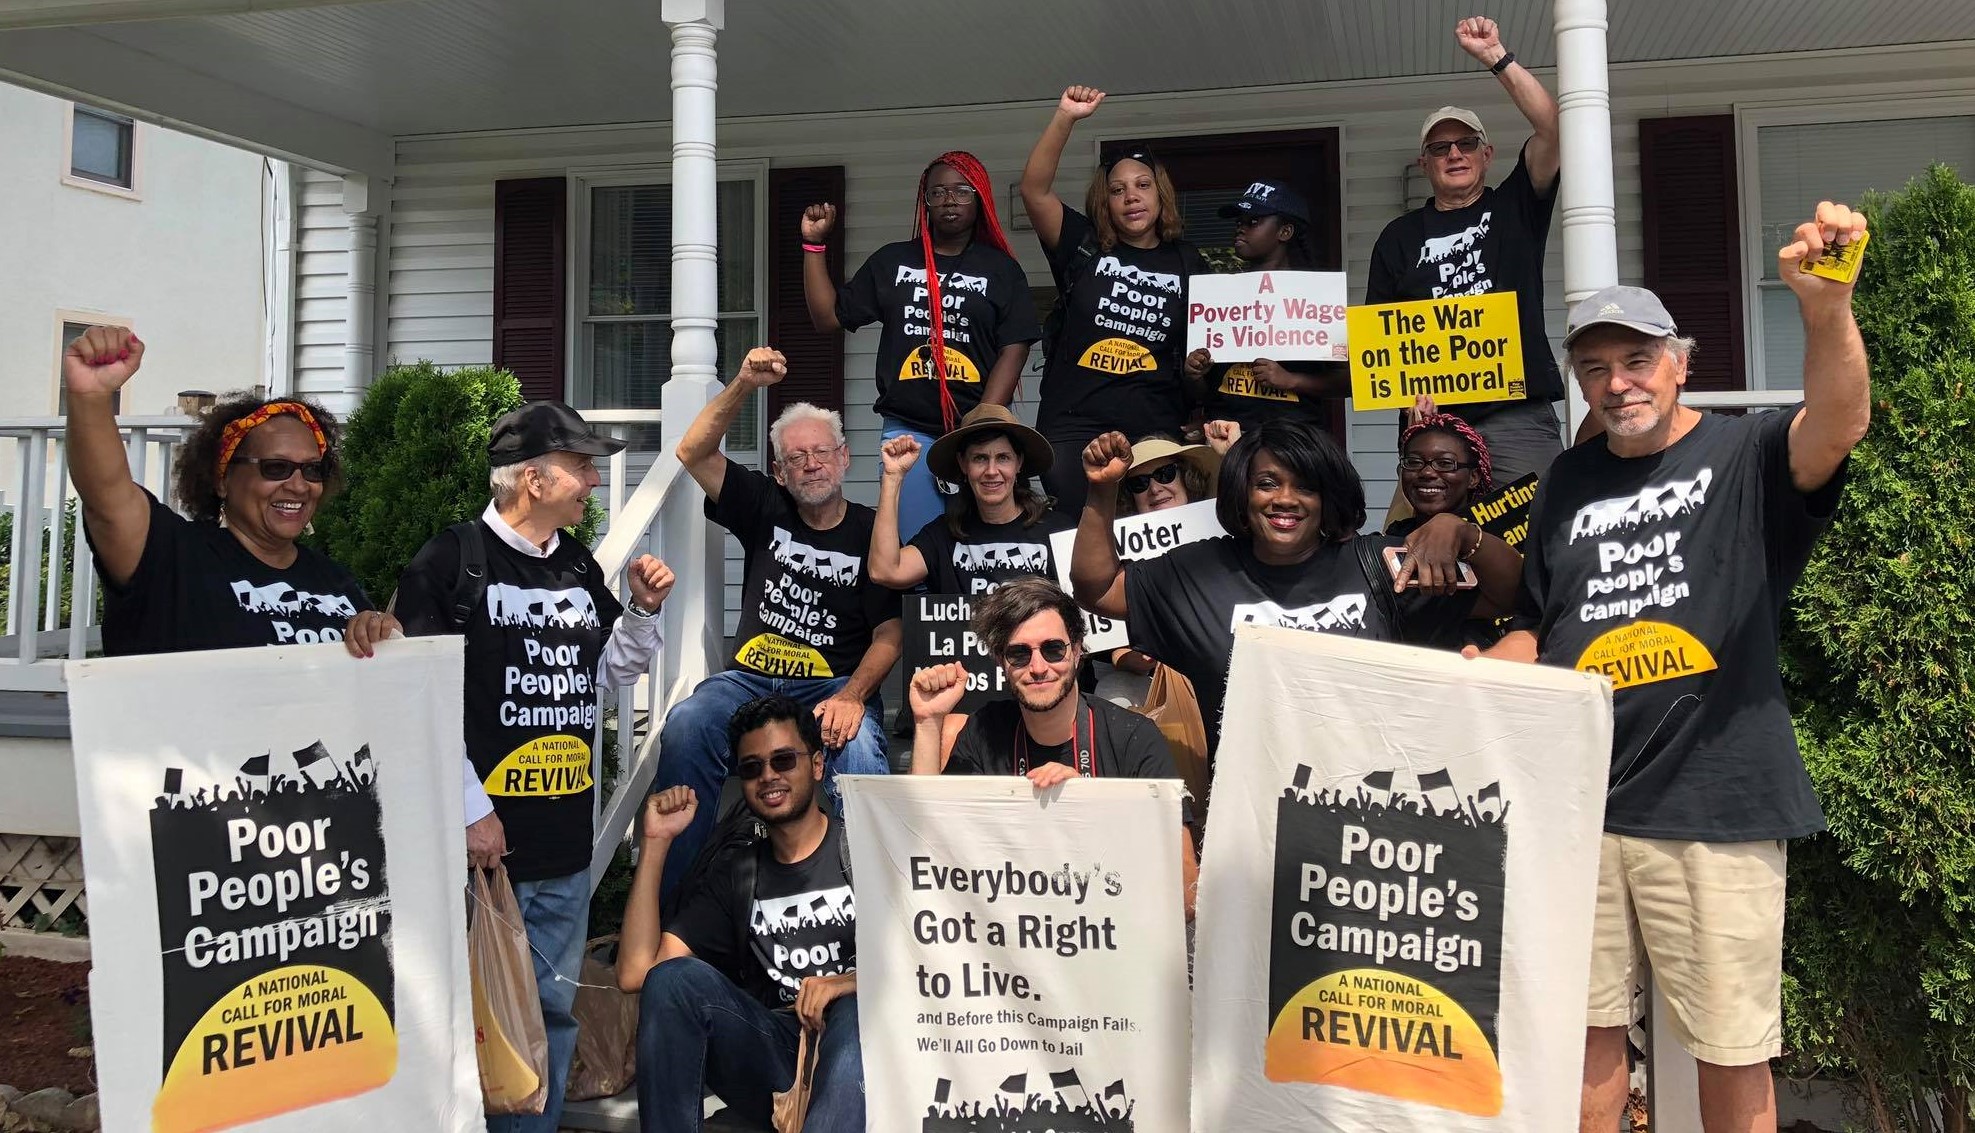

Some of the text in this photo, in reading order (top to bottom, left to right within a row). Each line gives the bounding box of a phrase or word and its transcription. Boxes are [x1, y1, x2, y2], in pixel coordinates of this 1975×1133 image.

[913, 286, 965, 309] Por
[1111, 281, 1166, 309] Poor
[1258, 272, 1274, 294] A
[904, 305, 969, 327] Peole's
[1098, 297, 1171, 327] People's
[1190, 298, 1345, 324] Poverty Wage
[1378, 304, 1484, 335] The War
[904, 323, 970, 343] Camaign
[1094, 314, 1166, 342] Campaign
[1206, 325, 1328, 348] is Violence
[1100, 345, 1113, 353] CALL
[1362, 347, 1391, 368] on
[1399, 339, 1440, 365] the
[1449, 335, 1508, 361] Poor
[1370, 373, 1392, 399] is
[1400, 362, 1504, 396] Immoral
[1598, 531, 1682, 573] Poor
[779, 572, 822, 606] Poor
[271, 620, 346, 645] Poo
[929, 631, 955, 656] La
[1605, 636, 1612, 646] A
[523, 638, 581, 667] Poor
[783, 649, 811, 659] MORAL
[1593, 649, 1616, 660] CALL
[1639, 635, 1676, 650] MORAL
[518, 754, 542, 764] CALL
[545, 753, 562, 764] FOR
[532, 740, 580, 751] A NATIONAL
[227, 817, 332, 863] Poor
[1341, 824, 1443, 874] Poor
[188, 850, 370, 916] People's
[910, 856, 1123, 905] Everybody's
[1300, 862, 1480, 922] People's
[185, 904, 378, 968] Campaign
[914, 909, 1117, 957] Got a Right
[1290, 911, 1482, 972] Campaign
[773, 941, 841, 970] Poor
[242, 970, 329, 1000] A NATIONAL
[916, 962, 1041, 1001] to Live.
[1339, 974, 1424, 997] A NATIONAL
[222, 986, 347, 1024] CALL FOR MORAL
[1319, 989, 1444, 1018] CALL FOR MORAL
[917, 1012, 942, 1024] and
[947, 1011, 993, 1026] Before
[997, 1010, 1024, 1023] this
[1027, 1012, 1099, 1032] Campaign
[1302, 1006, 1463, 1060] REVIVAL
[203, 1004, 364, 1075] REVIVAL
[917, 1037, 1083, 1056] We'll All Go Down to Jail
